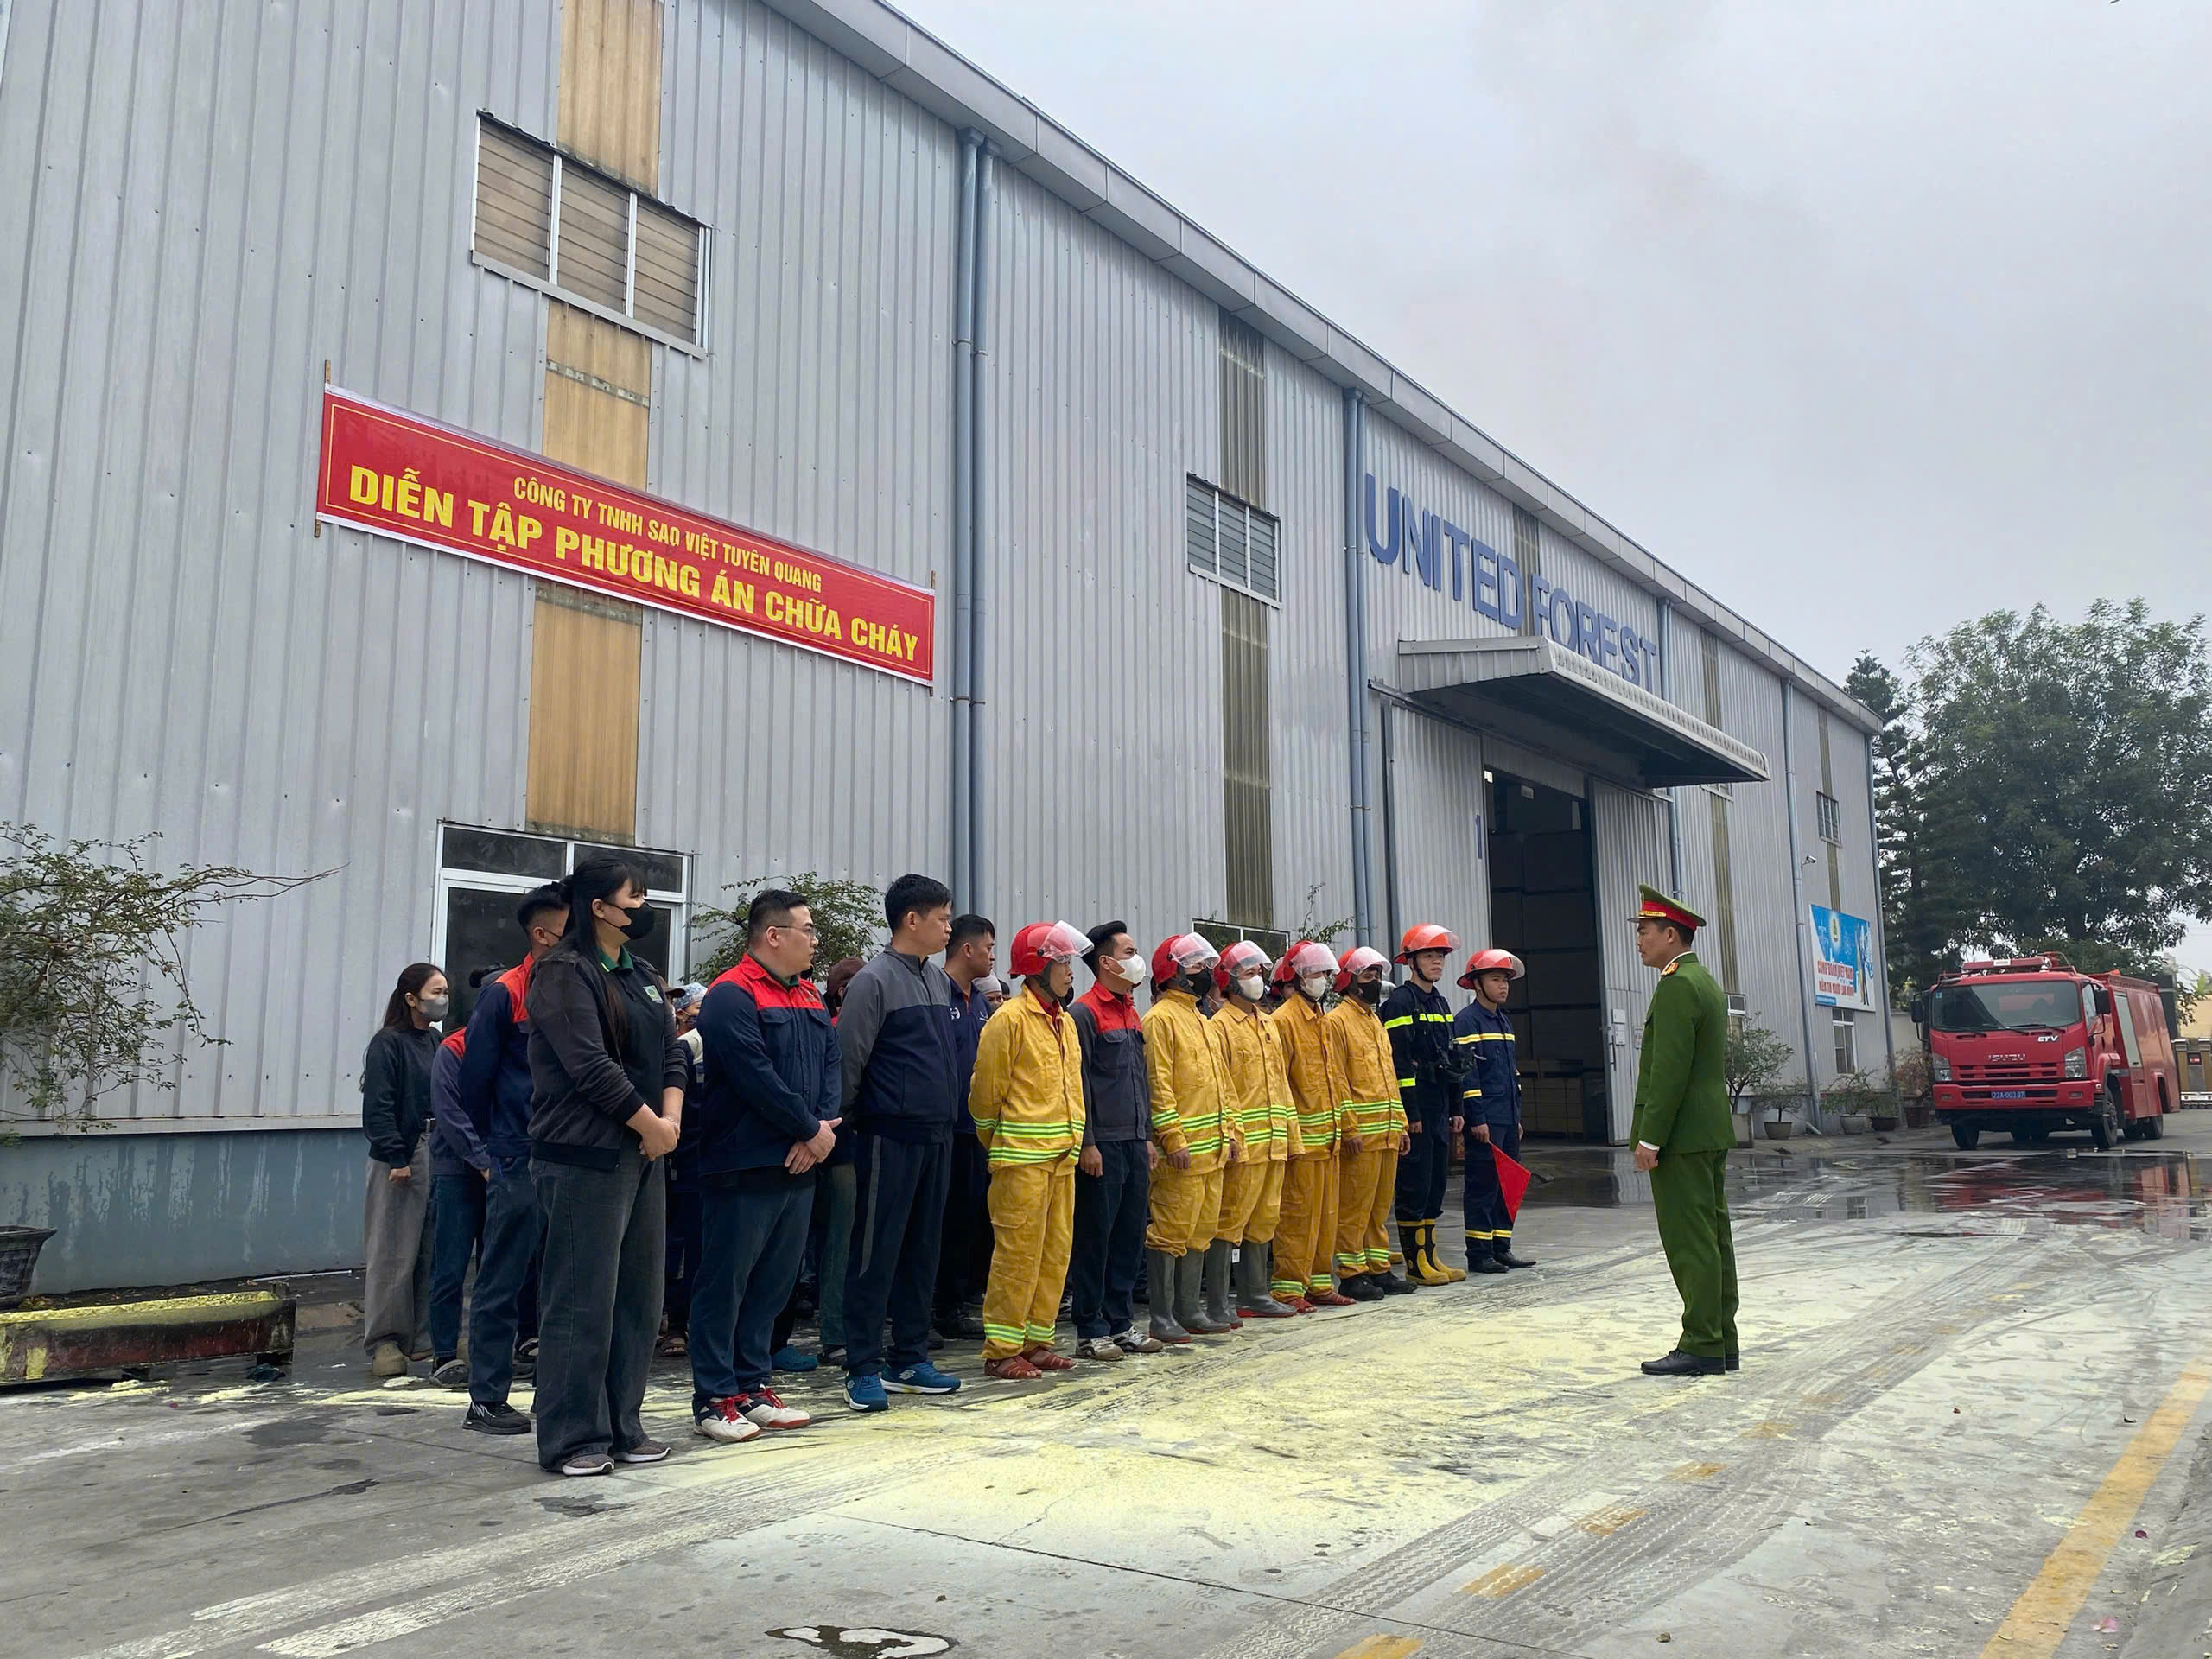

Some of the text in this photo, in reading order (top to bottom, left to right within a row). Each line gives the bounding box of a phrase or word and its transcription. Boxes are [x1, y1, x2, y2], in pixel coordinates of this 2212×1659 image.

[349, 464, 919, 662] DIỄN TẬP PHƯƠNG ÁN CHỮA CHÁY
[514, 476, 822, 594] CÔNG TY TNHH SAO VIỆT TUYÊN QUANG
[1365, 473, 1657, 693] UNITED FOREST
[1987, 1053, 2026, 1062] ISUZU
